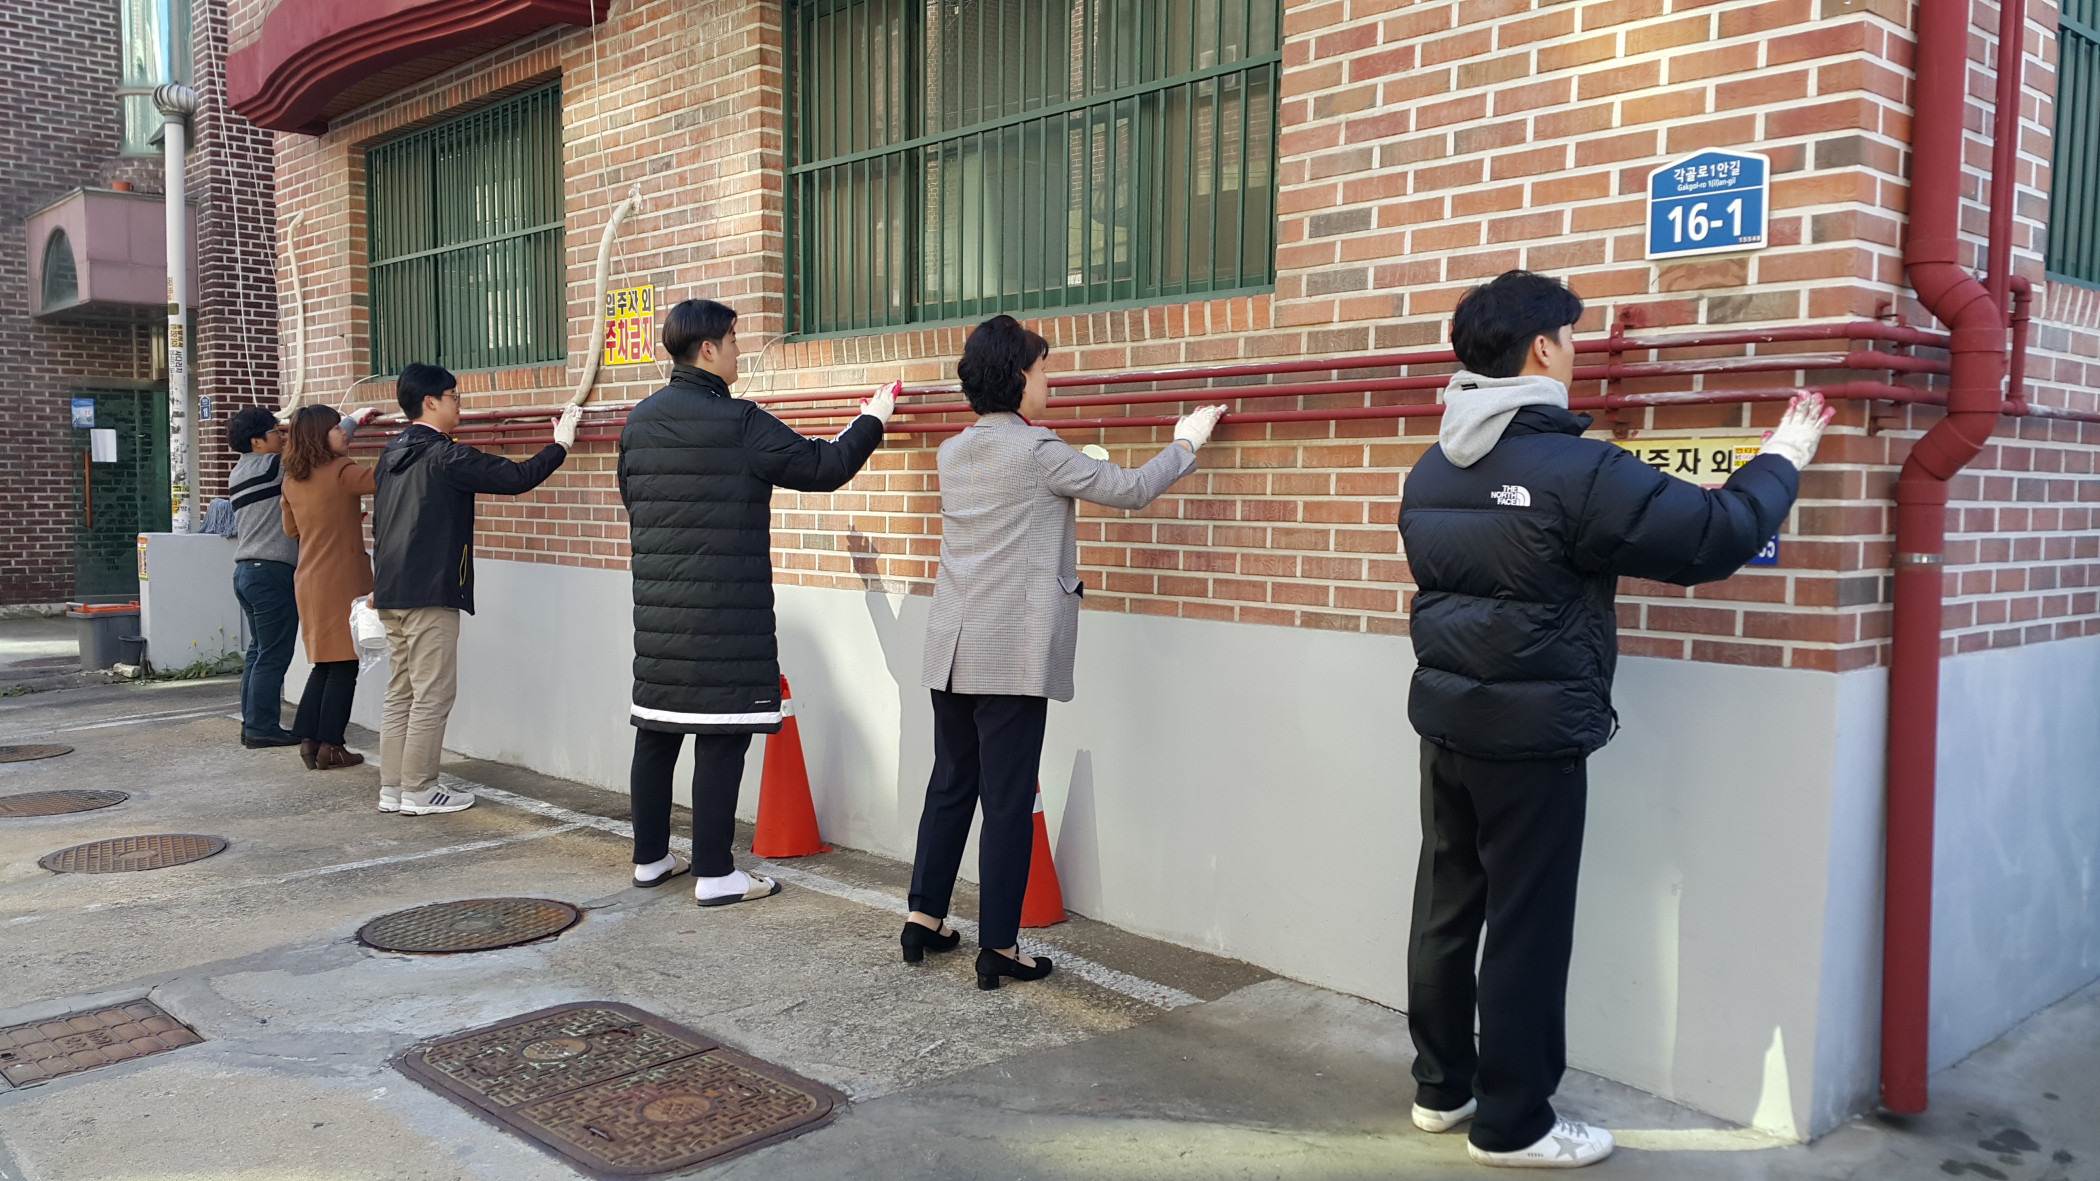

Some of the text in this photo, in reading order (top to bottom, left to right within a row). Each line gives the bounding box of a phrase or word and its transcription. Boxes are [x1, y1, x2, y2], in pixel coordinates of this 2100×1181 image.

[1674, 160, 1741, 183] 각골로1안길
[1668, 198, 1742, 243] 16-1
[606, 288, 651, 316] 입주자 외
[606, 316, 653, 361] 주차금지
[1711, 449, 1732, 474] 외
[1490, 491, 1517, 499] NORTH
[1502, 484, 1518, 492] THE
[1497, 498, 1517, 506] FACE
